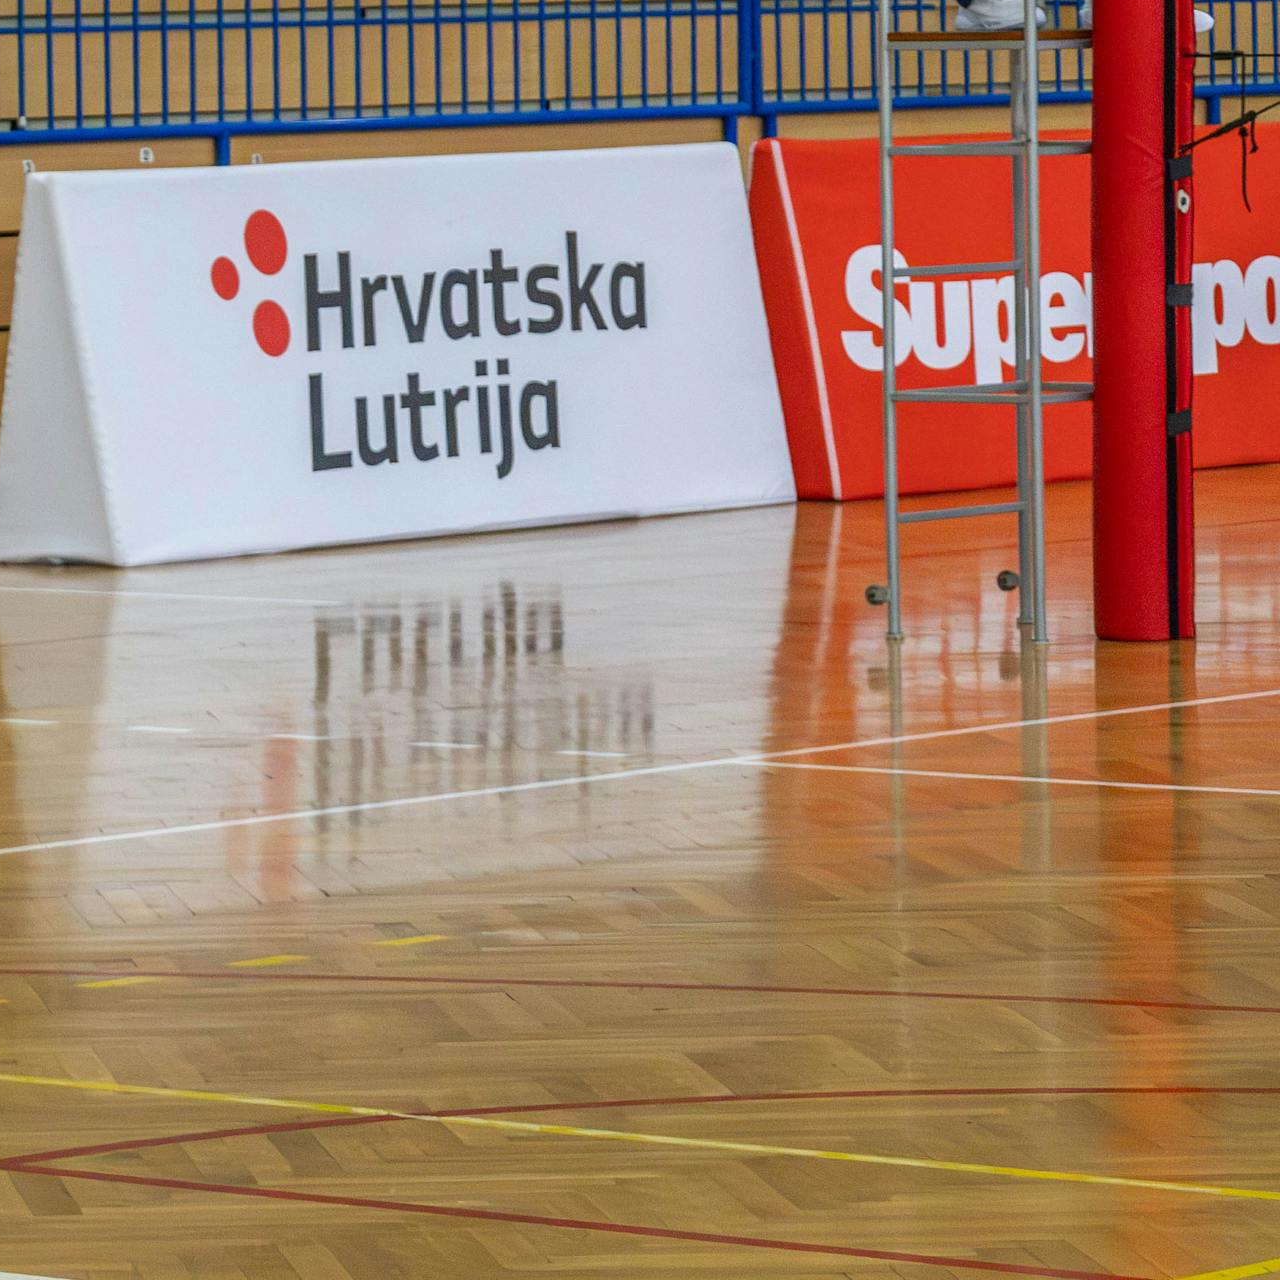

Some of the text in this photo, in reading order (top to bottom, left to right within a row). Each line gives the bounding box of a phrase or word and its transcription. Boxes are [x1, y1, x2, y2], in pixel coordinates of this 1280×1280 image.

[304, 230, 648, 352] Hrvatska
[840, 244, 1280, 386] Supepo
[307, 358, 561, 479] Lutrija
